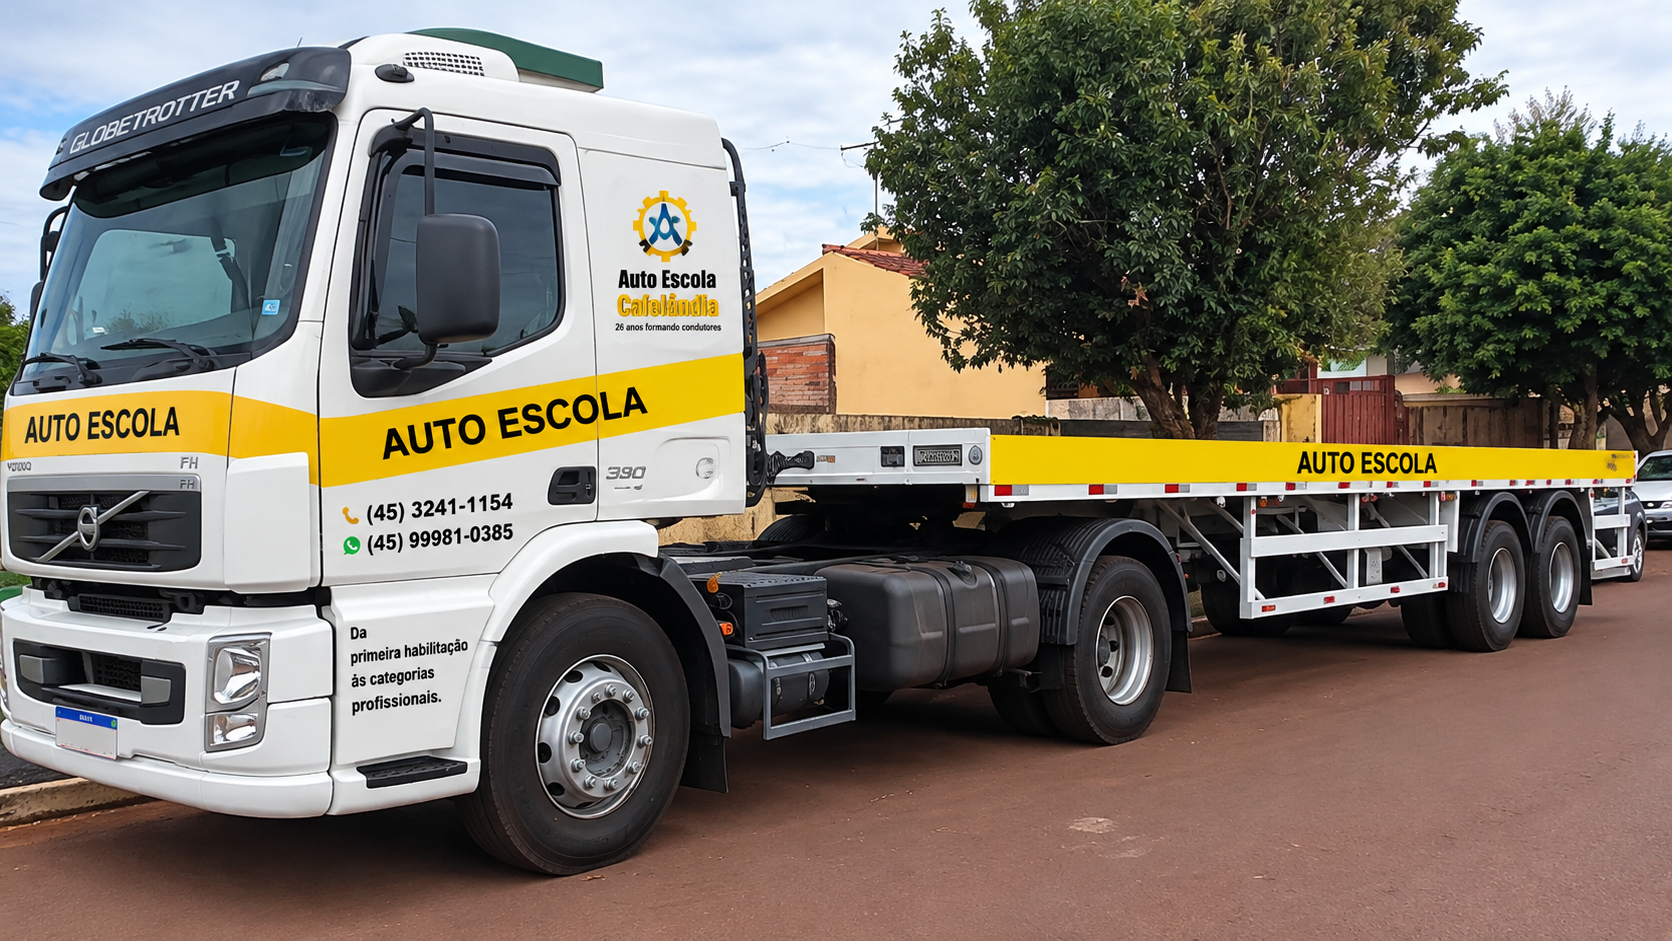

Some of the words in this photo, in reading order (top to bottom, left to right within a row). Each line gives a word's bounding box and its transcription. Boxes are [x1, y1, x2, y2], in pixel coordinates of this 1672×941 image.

[69, 79, 241, 154] GLOBETROTTER
[618, 269, 657, 289] Auto
[661, 269, 717, 289] Escola
[615, 323, 624, 331] 26
[645, 323, 680, 331] formando
[682, 323, 722, 331] condutores
[24, 412, 81, 444] AUTO
[87, 406, 180, 440] ESCOLA
[382, 414, 486, 460] AUTO
[498, 386, 648, 439] ESCOLA
[180, 456, 199, 470] FH
[606, 466, 647, 480] 390
[1297, 451, 1355, 474] AUTO
[1361, 452, 1437, 474] ESCOLA
[180, 479, 195, 490] FH
[367, 502, 405, 526] (45)
[411, 492, 513, 519] 3241-1154
[367, 532, 404, 556] (45)
[409, 523, 514, 549] 99981-0385
[350, 626, 367, 640] Da
[350, 646, 401, 667] primeira
[404, 638, 469, 658] habilitação
[370, 666, 435, 686] categorias
[351, 690, 442, 716] profissionais.
